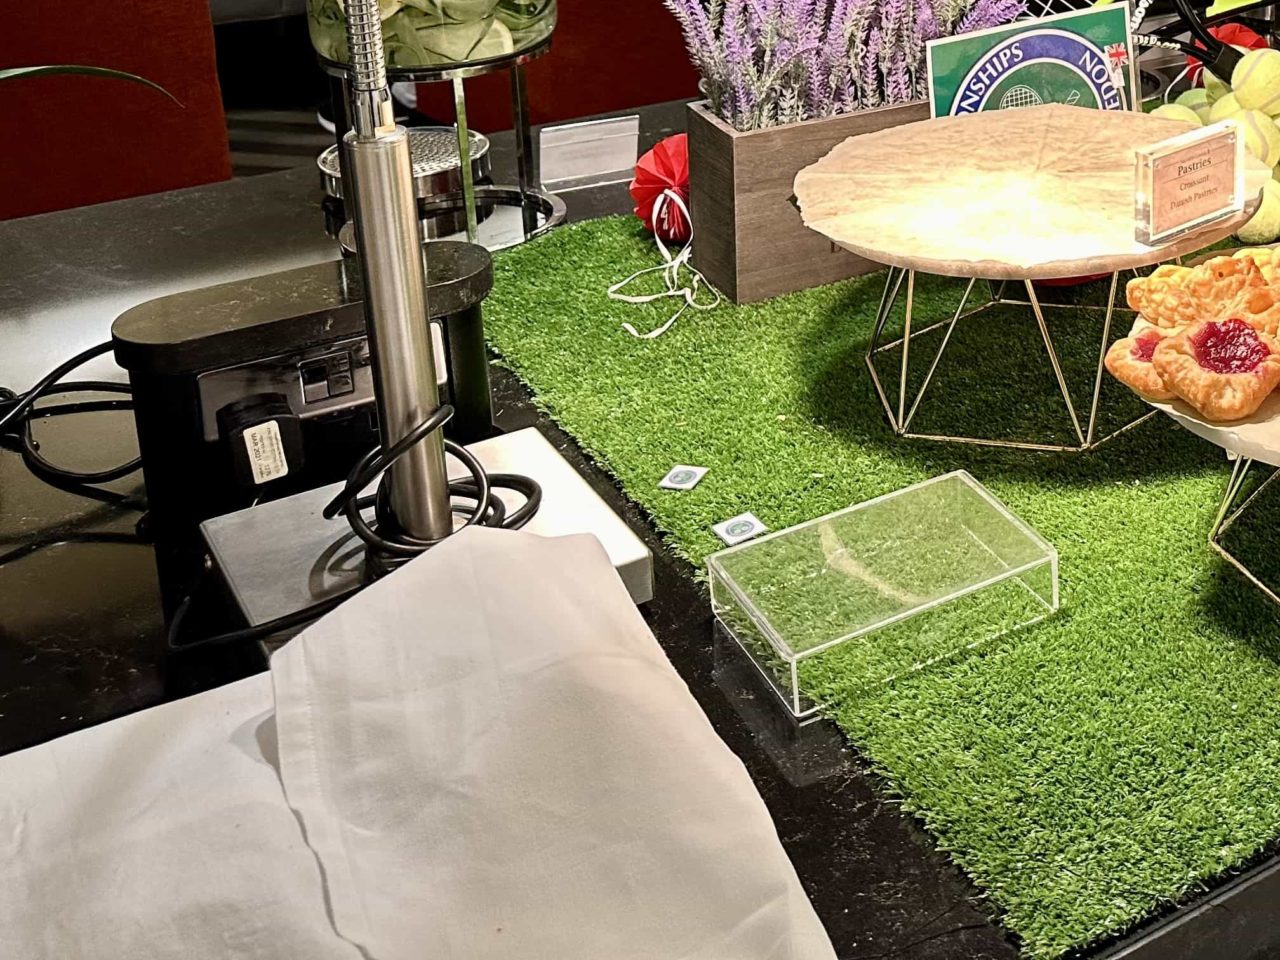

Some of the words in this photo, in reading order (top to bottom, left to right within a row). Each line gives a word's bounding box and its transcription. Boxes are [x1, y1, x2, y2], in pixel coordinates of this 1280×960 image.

[956, 42, 1024, 116] NSHIPS
[1177, 156, 1212, 176] Pastries
[1179, 175, 1209, 191] Croissant
[1170, 194, 1193, 210] Danish
[1193, 186, 1219, 201] Pastries
